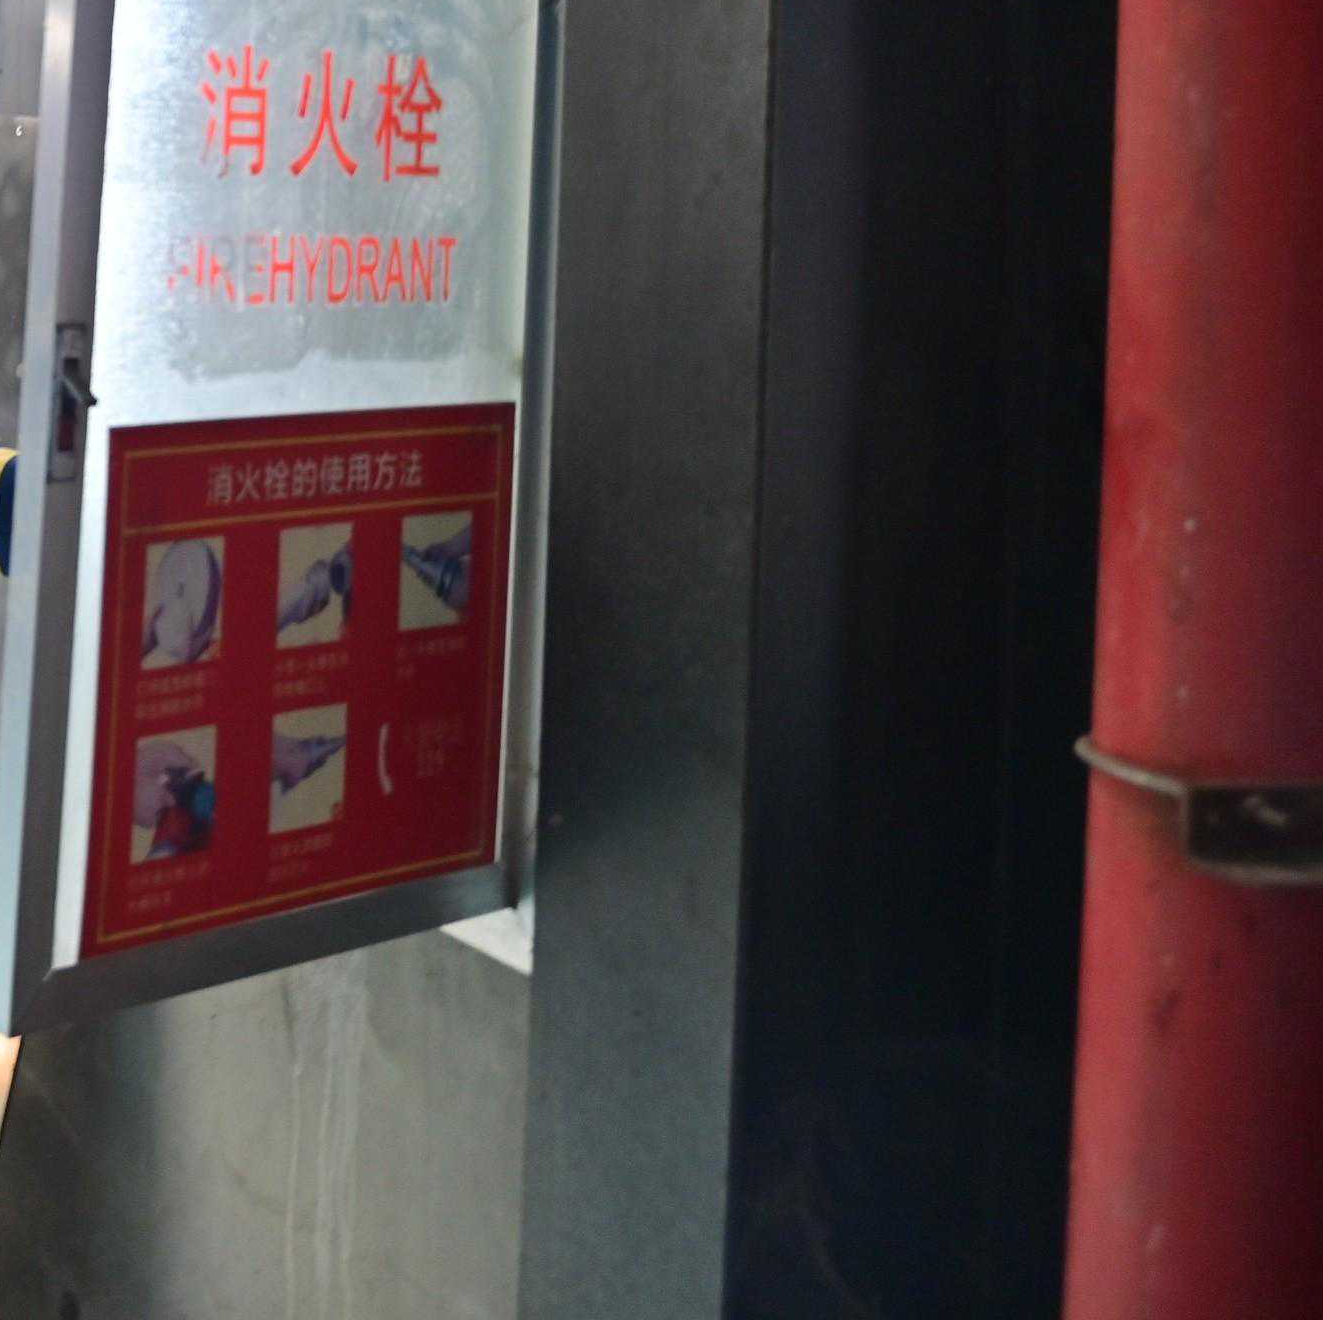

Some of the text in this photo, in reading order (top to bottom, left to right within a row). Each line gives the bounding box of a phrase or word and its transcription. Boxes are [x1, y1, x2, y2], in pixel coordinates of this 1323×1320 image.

[201, 44, 443, 181] 消火栓
[206, 450, 423, 506] 消火栓的使用方法
